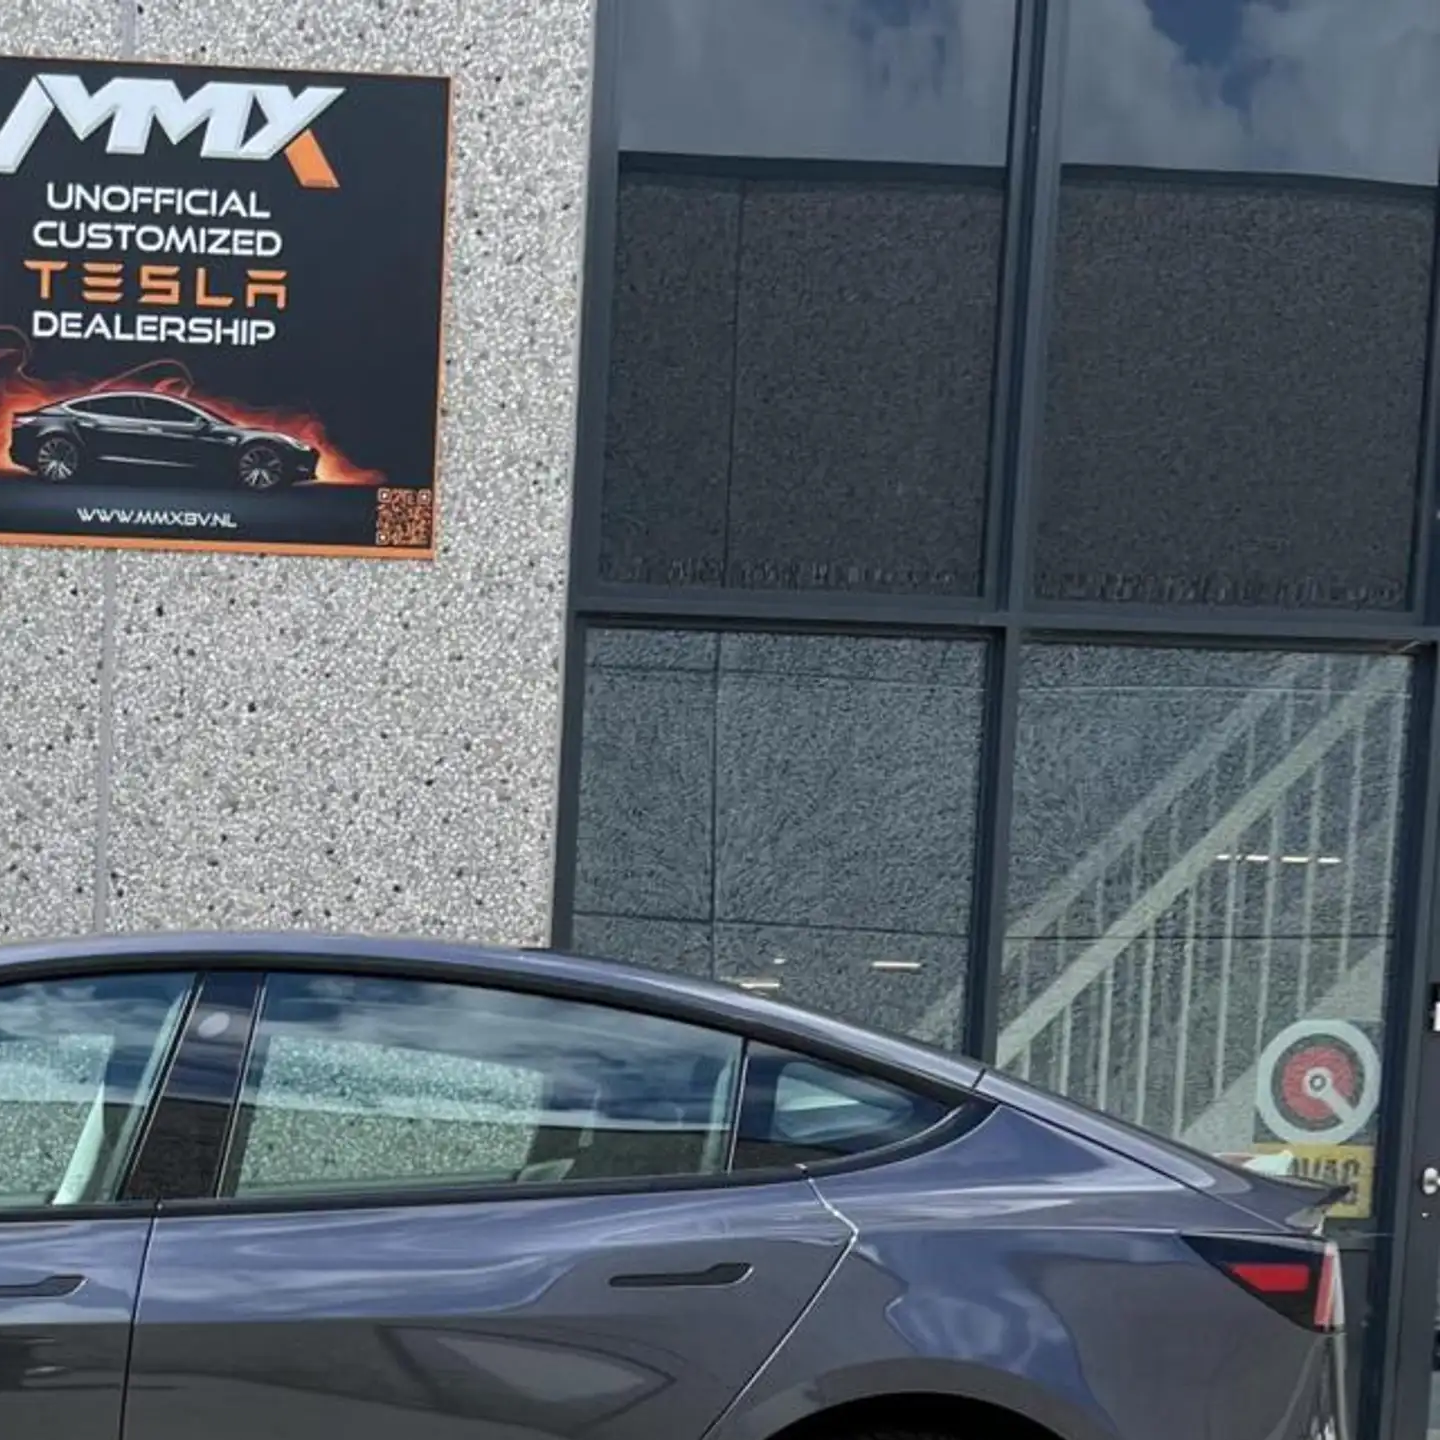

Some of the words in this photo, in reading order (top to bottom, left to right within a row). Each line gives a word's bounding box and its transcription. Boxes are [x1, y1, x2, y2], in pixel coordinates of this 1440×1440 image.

[46, 182, 271, 219] UNOFFICIAL
[32, 220, 282, 256] CUSTOMIZED
[23, 259, 287, 309] TESLA
[32, 310, 276, 346] DEALERSHIP
